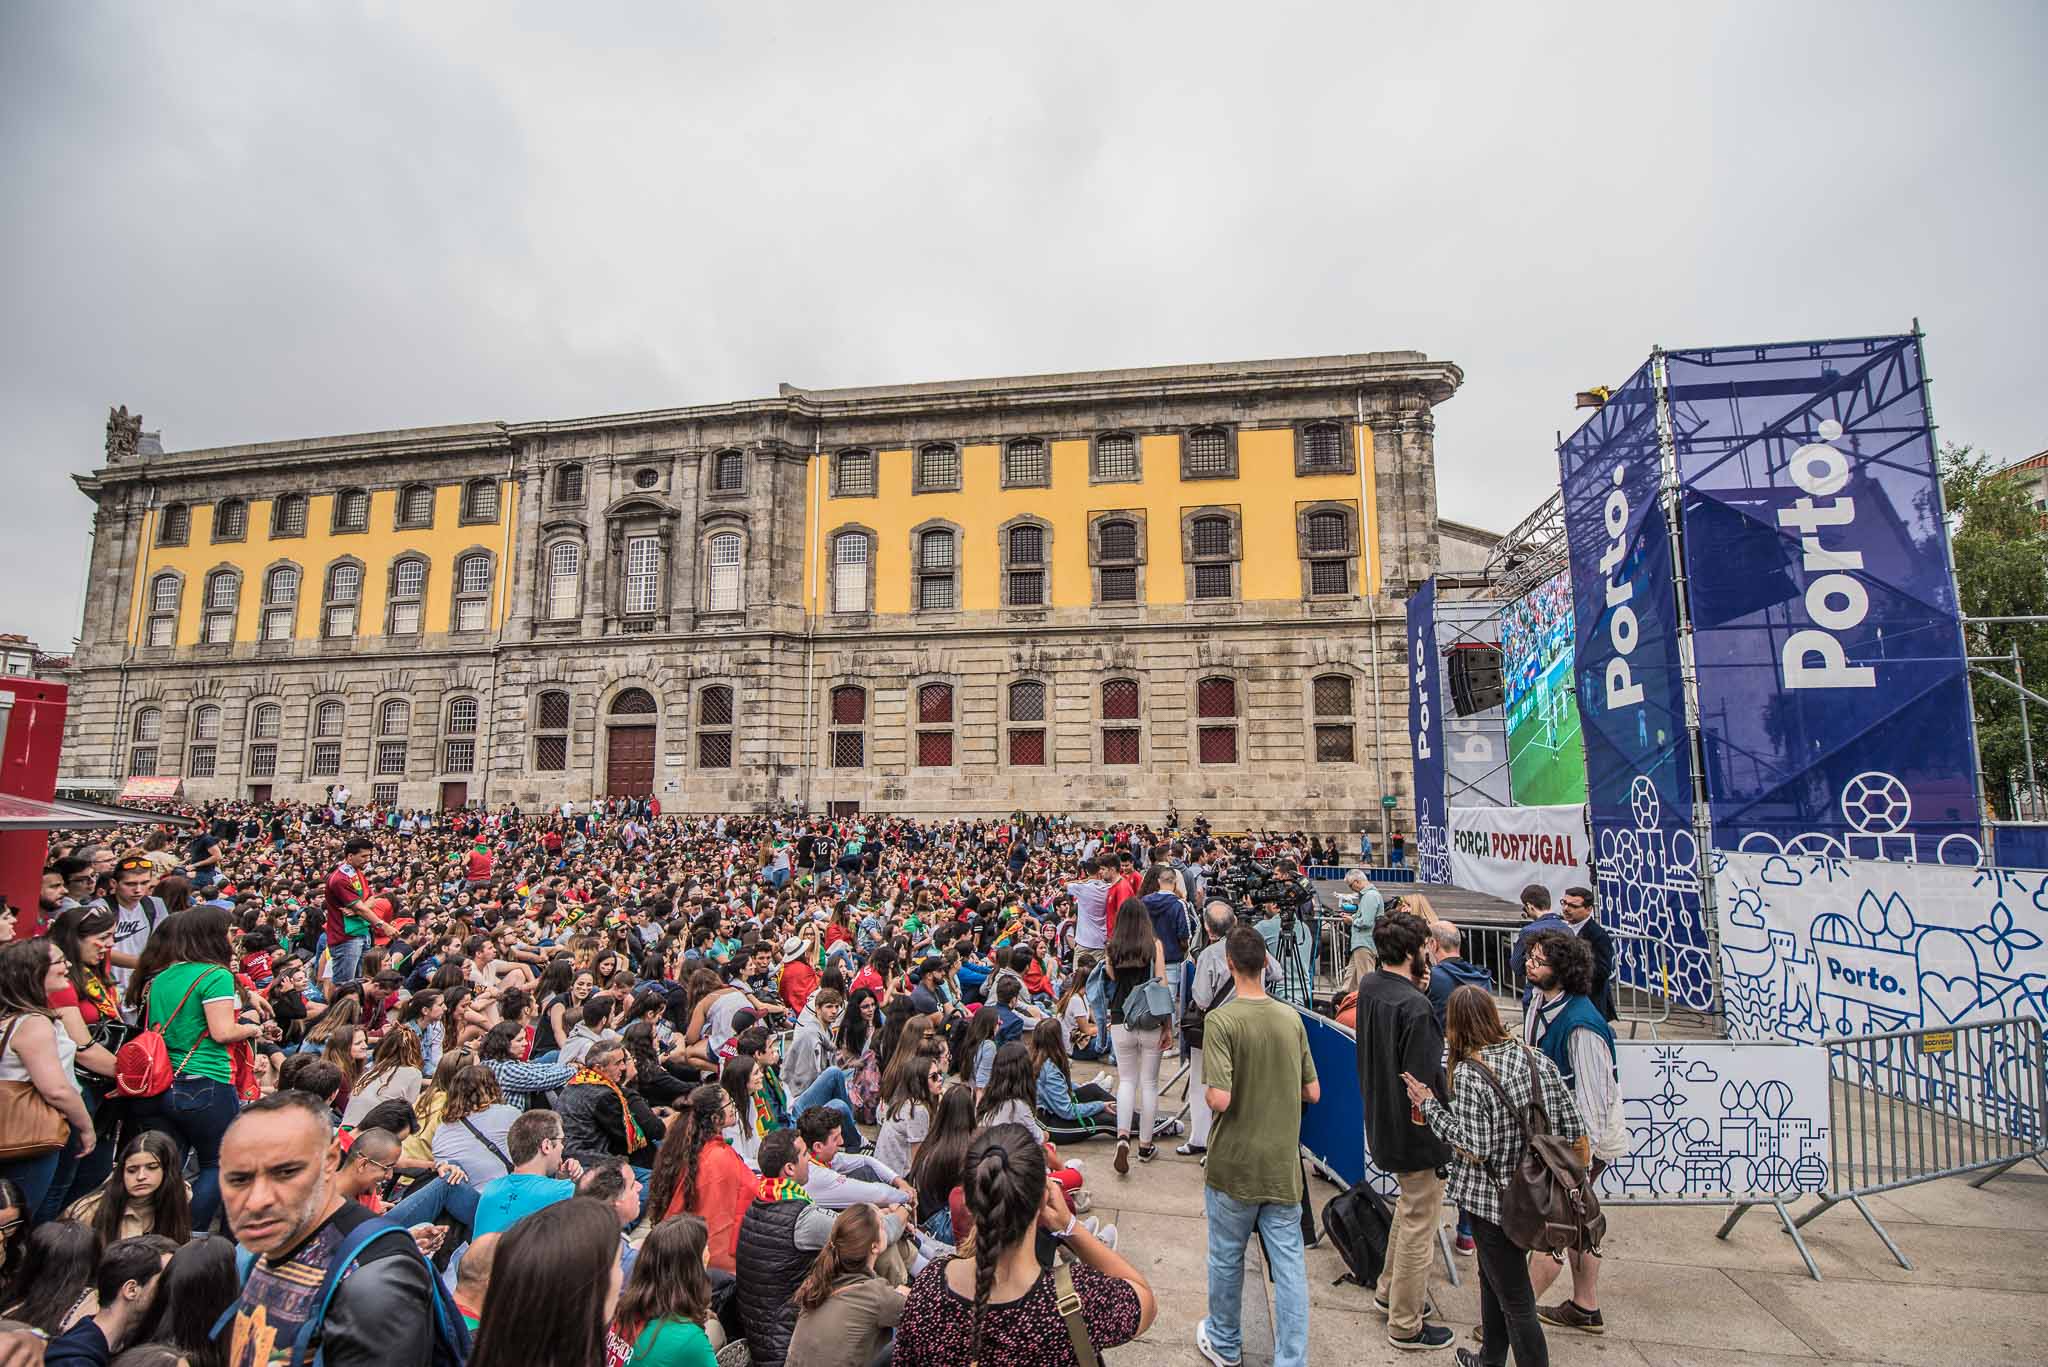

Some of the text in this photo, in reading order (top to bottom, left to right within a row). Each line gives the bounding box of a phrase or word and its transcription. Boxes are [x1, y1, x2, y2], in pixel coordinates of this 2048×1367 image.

[1600, 465, 1644, 710] Porto.
[1777, 419, 1876, 689] Porto.
[1416, 625, 1431, 760] Porto.
[816, 841, 828, 855] 12
[1454, 829, 1578, 867] FORÇA PORTUGAL
[1826, 956, 1906, 995] Porto.
